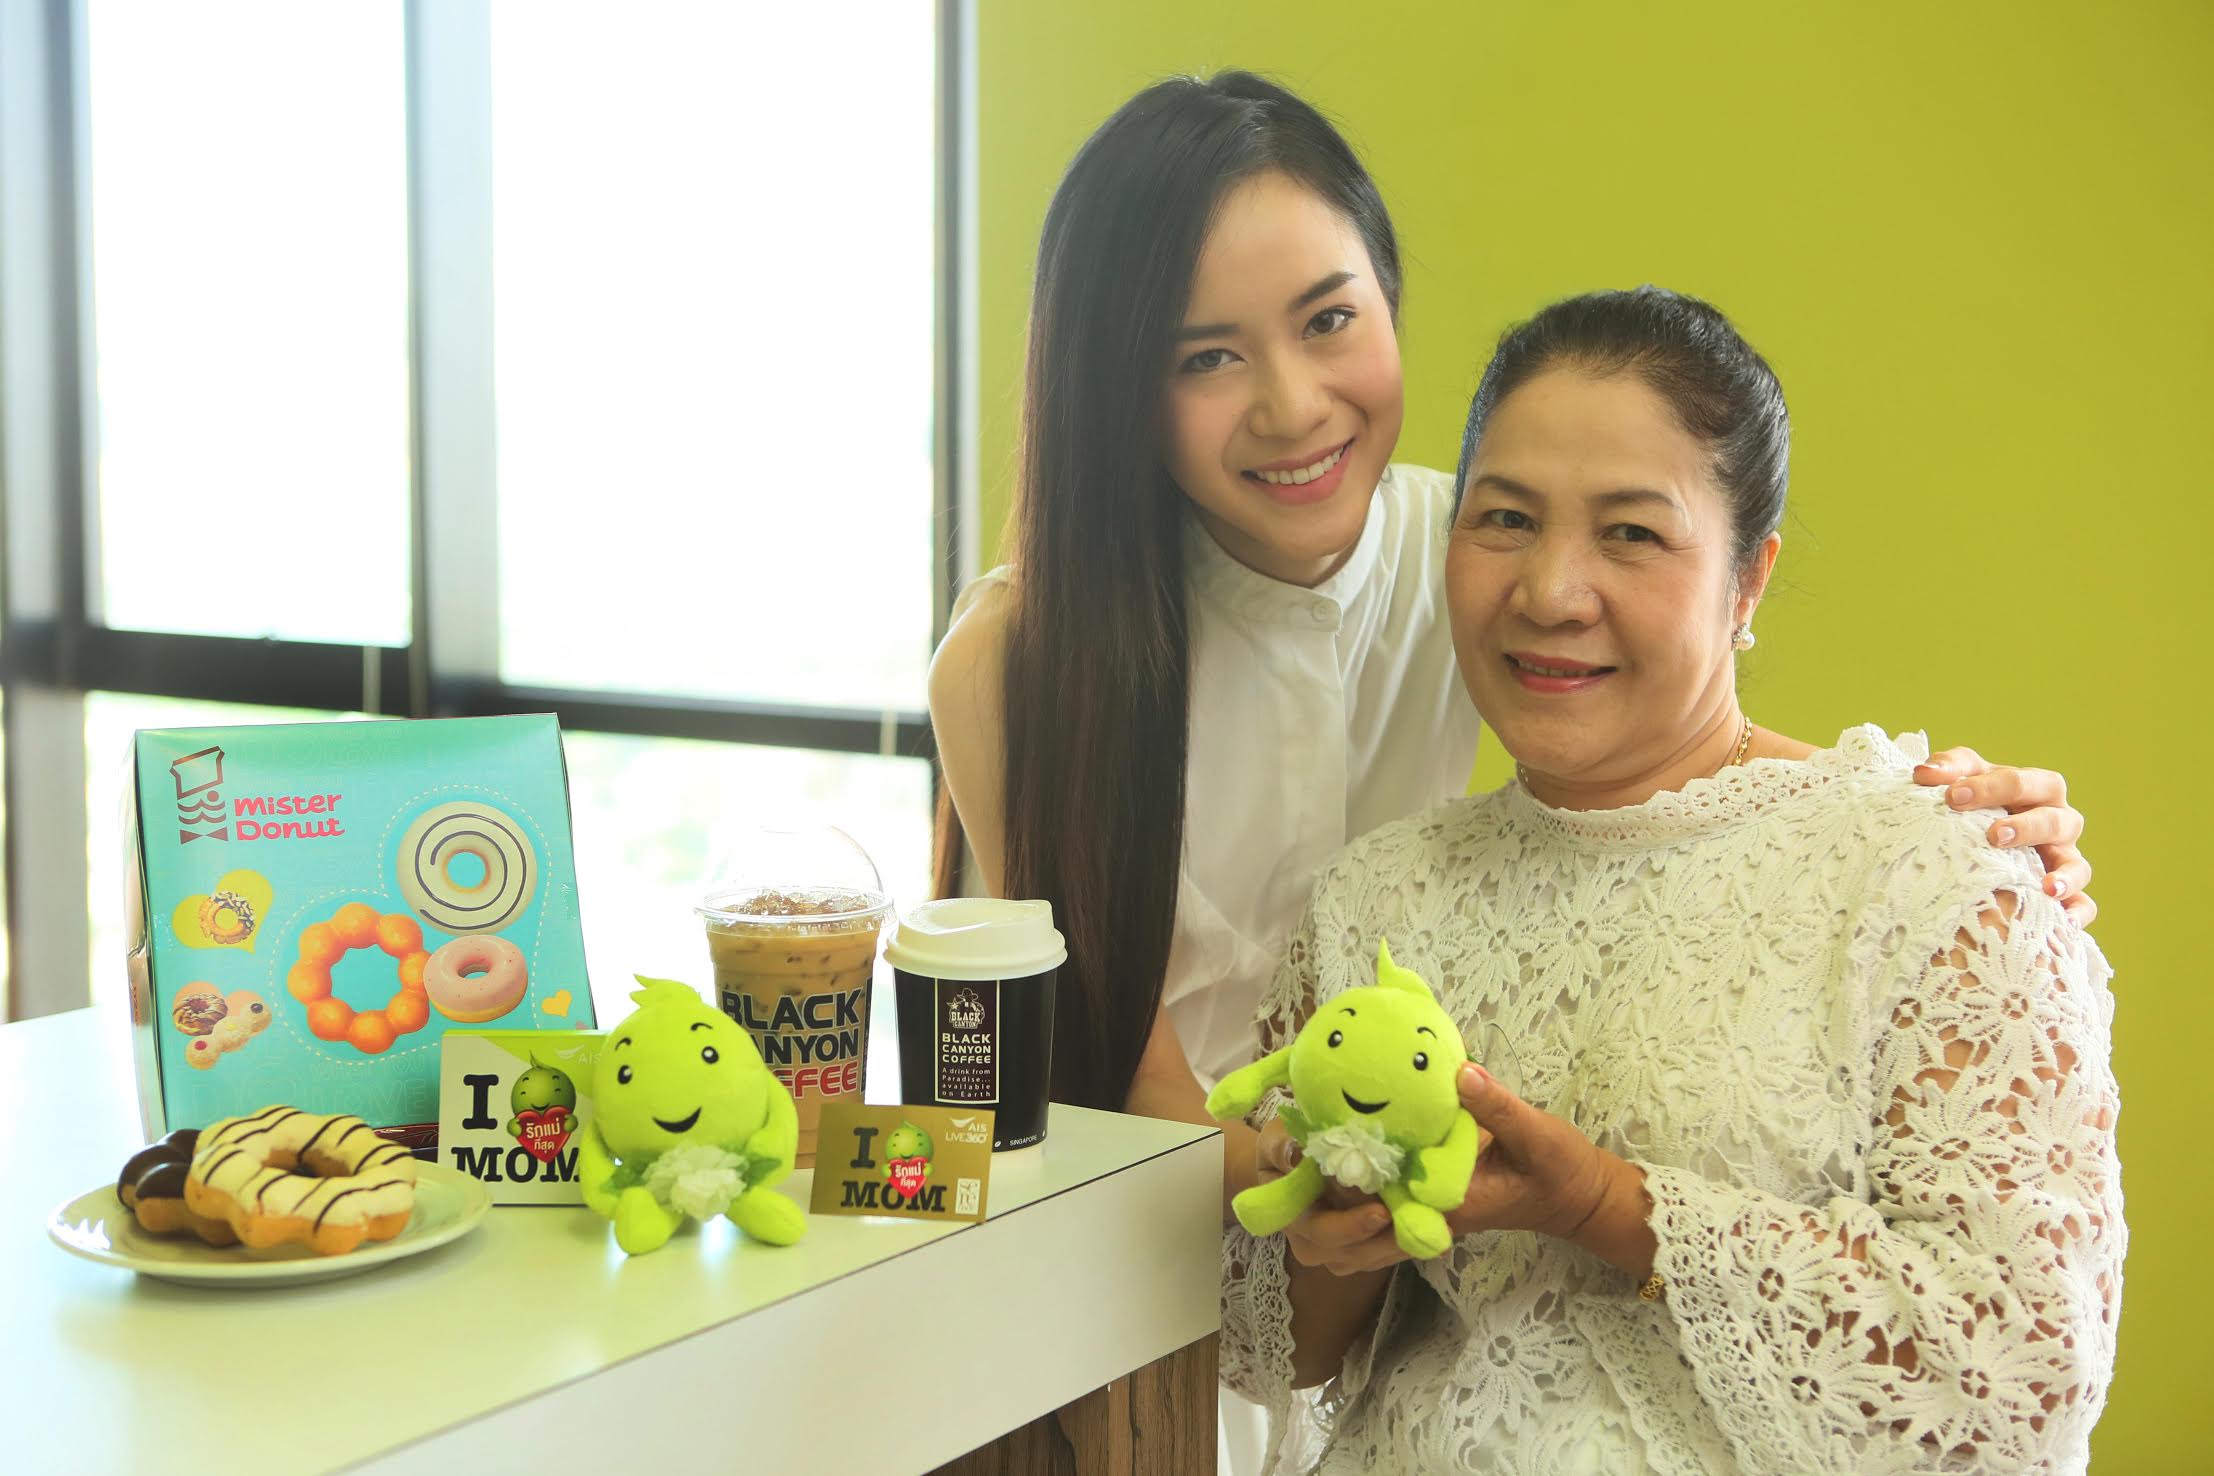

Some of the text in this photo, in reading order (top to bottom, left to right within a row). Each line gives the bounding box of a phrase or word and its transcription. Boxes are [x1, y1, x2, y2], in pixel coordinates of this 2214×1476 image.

[236, 818, 345, 841] Donut
[722, 988, 863, 1031] BLACK
[951, 1011, 981, 1022] BLACK
[750, 1027, 860, 1066] NYON
[942, 1032, 991, 1044] BLACK
[942, 1044, 991, 1054] CANYON
[942, 1054, 991, 1064] COFFEE
[942, 1066, 947, 1074] A
[950, 1067, 970, 1075] drink
[942, 1083, 991, 1091] available
[462, 1074, 499, 1129] I
[526, 1117, 560, 1139] รักแม่
[968, 1122, 988, 1133] AIS
[850, 1127, 879, 1169] I
[1009, 1134, 1038, 1147] SINGAPORE
[451, 1146, 580, 1183] MOM
[840, 1180, 947, 1213] MOM
